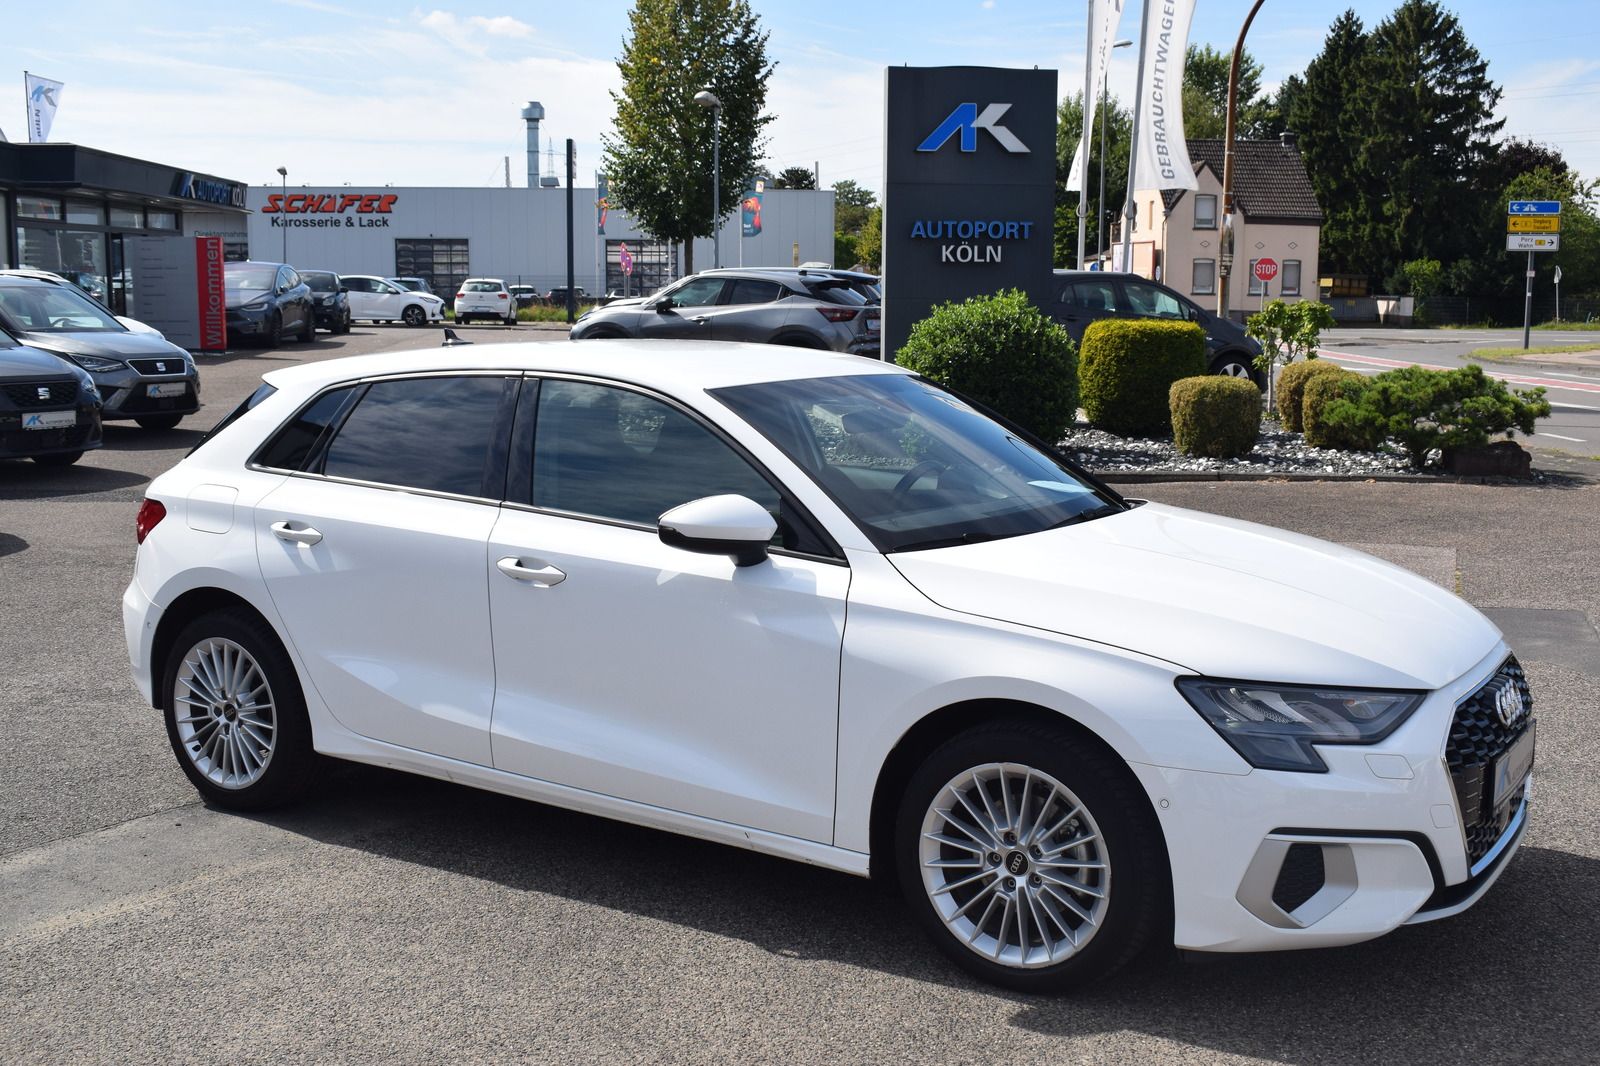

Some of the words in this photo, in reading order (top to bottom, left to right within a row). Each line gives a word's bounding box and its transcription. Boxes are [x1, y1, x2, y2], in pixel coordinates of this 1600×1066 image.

[915, 102, 1031, 153] AK
[262, 193, 398, 213] SCHÄFER
[271, 216, 341, 228] Karosserie
[345, 217, 355, 228] &
[358, 216, 389, 228] Lack
[911, 220, 1034, 240] AUTOPORT
[941, 241, 1002, 263] KÖLN
[1256, 265, 1277, 275] STOP
[206, 239, 222, 346] Willkommen
